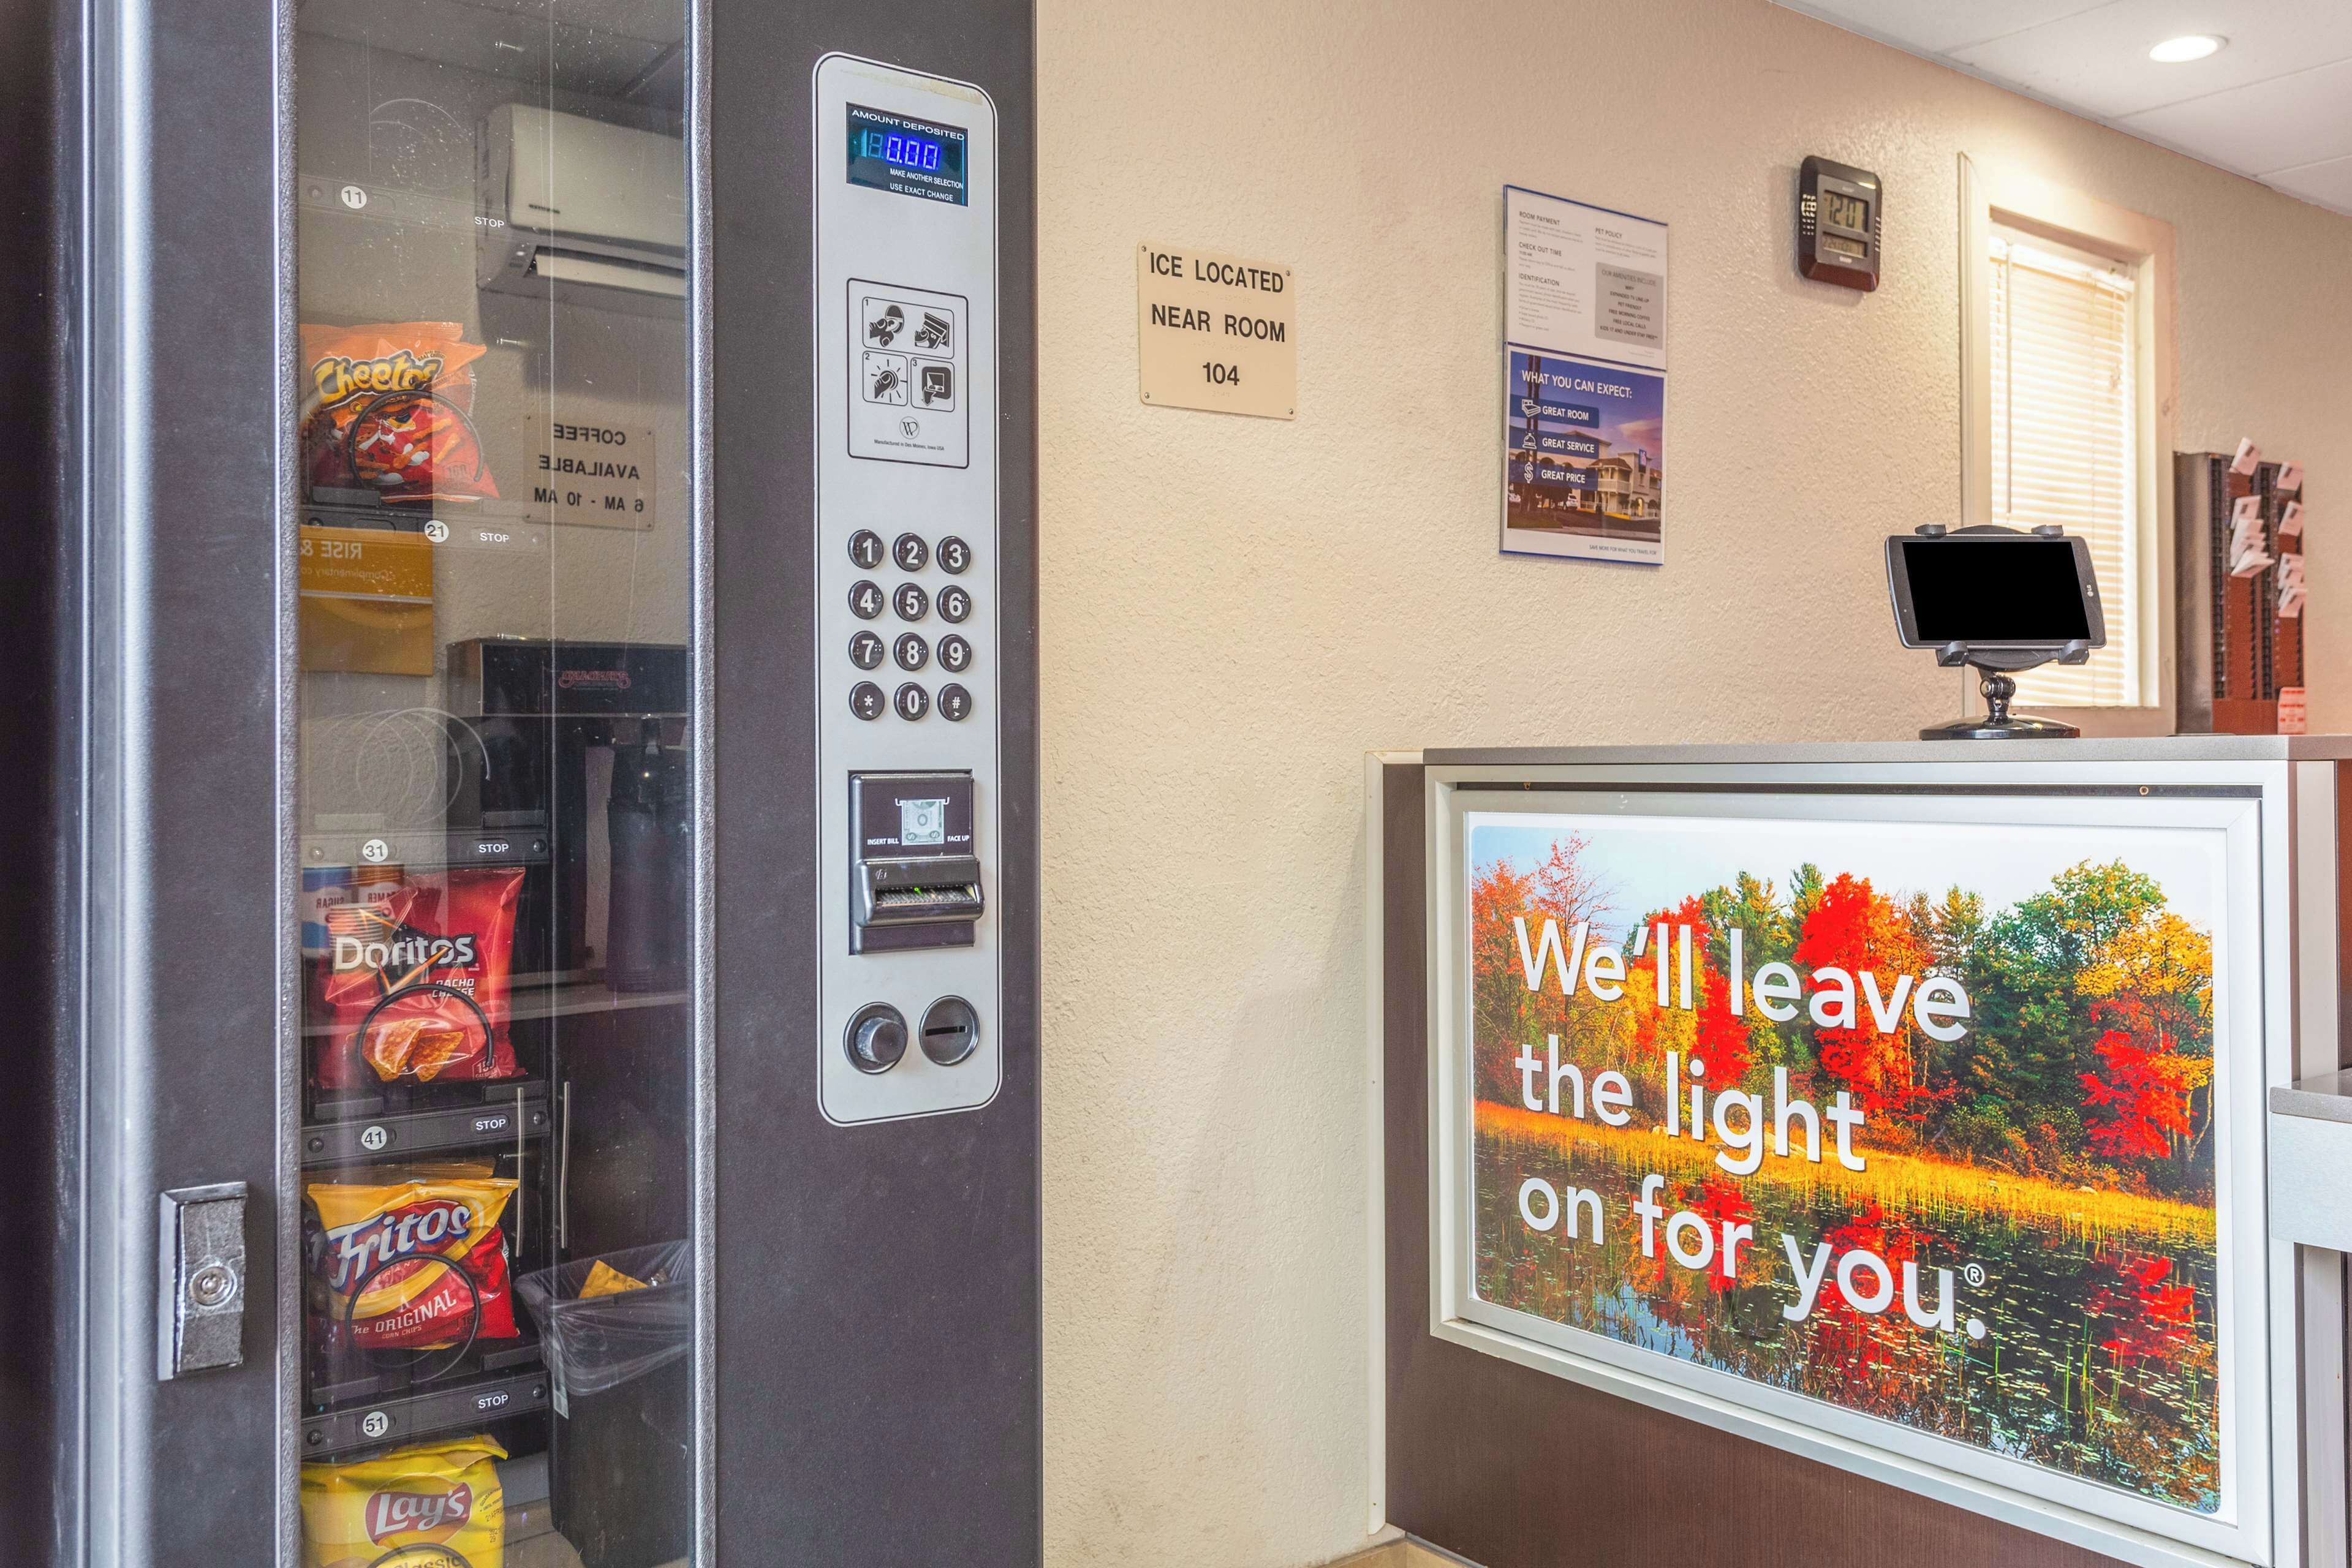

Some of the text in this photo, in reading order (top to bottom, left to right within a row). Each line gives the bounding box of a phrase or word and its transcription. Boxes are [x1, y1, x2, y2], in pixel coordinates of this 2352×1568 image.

[852, 110, 964, 140] AMOUNT DEPOSITED
[890, 168, 963, 189] MAKE ANOTHER SELECTION
[344, 189, 364, 205] 11
[890, 183, 953, 202] USE EXACT CHANGE
[474, 216, 504, 229] STOP
[1519, 211, 1560, 225] ROOM PAYMENT
[1605, 230, 1622, 239] POLICY
[1519, 241, 1537, 251] CHECK
[1549, 248, 1562, 257] TIME
[1151, 252, 1284, 293] ICE LOCATED
[1519, 273, 1560, 286] IDENTIFICATION
[1152, 303, 1285, 342] NEAR ROOM
[313, 353, 439, 403] Cheetos
[1203, 362, 1240, 386] 104
[1521, 370, 1632, 399] WHAT YOU CAN EXPECT:
[1542, 405, 1589, 421] GREAT ROOM
[1542, 437, 1595, 453] GREAT SERVICE
[1541, 469, 1586, 483] GREAT PRICE
[426, 524, 445, 538] 21
[480, 532, 510, 543] STOP
[863, 538, 962, 567] 1 2 3
[860, 589, 962, 616] 4 5 6
[861, 639, 962, 666] 7 8 9
[907, 690, 919, 714] 0
[365, 844, 384, 858] 31
[478, 843, 509, 853] STOP
[335, 933, 476, 970] Doritos
[1513, 916, 1971, 1042] We'll leave
[1514, 1034, 1866, 1176] the light
[475, 1118, 506, 1131] STOP
[365, 1130, 384, 1145] 41
[1518, 1177, 1604, 1246] on
[1633, 1174, 1753, 1278] for
[328, 1205, 471, 1288] Fritos
[376, 1289, 457, 1333] ORIGINAL
[402, 1325, 422, 1336] CHIPS
[478, 1394, 509, 1409] STOP
[366, 1416, 385, 1432] 51
[375, 1488, 466, 1536] Lay's
